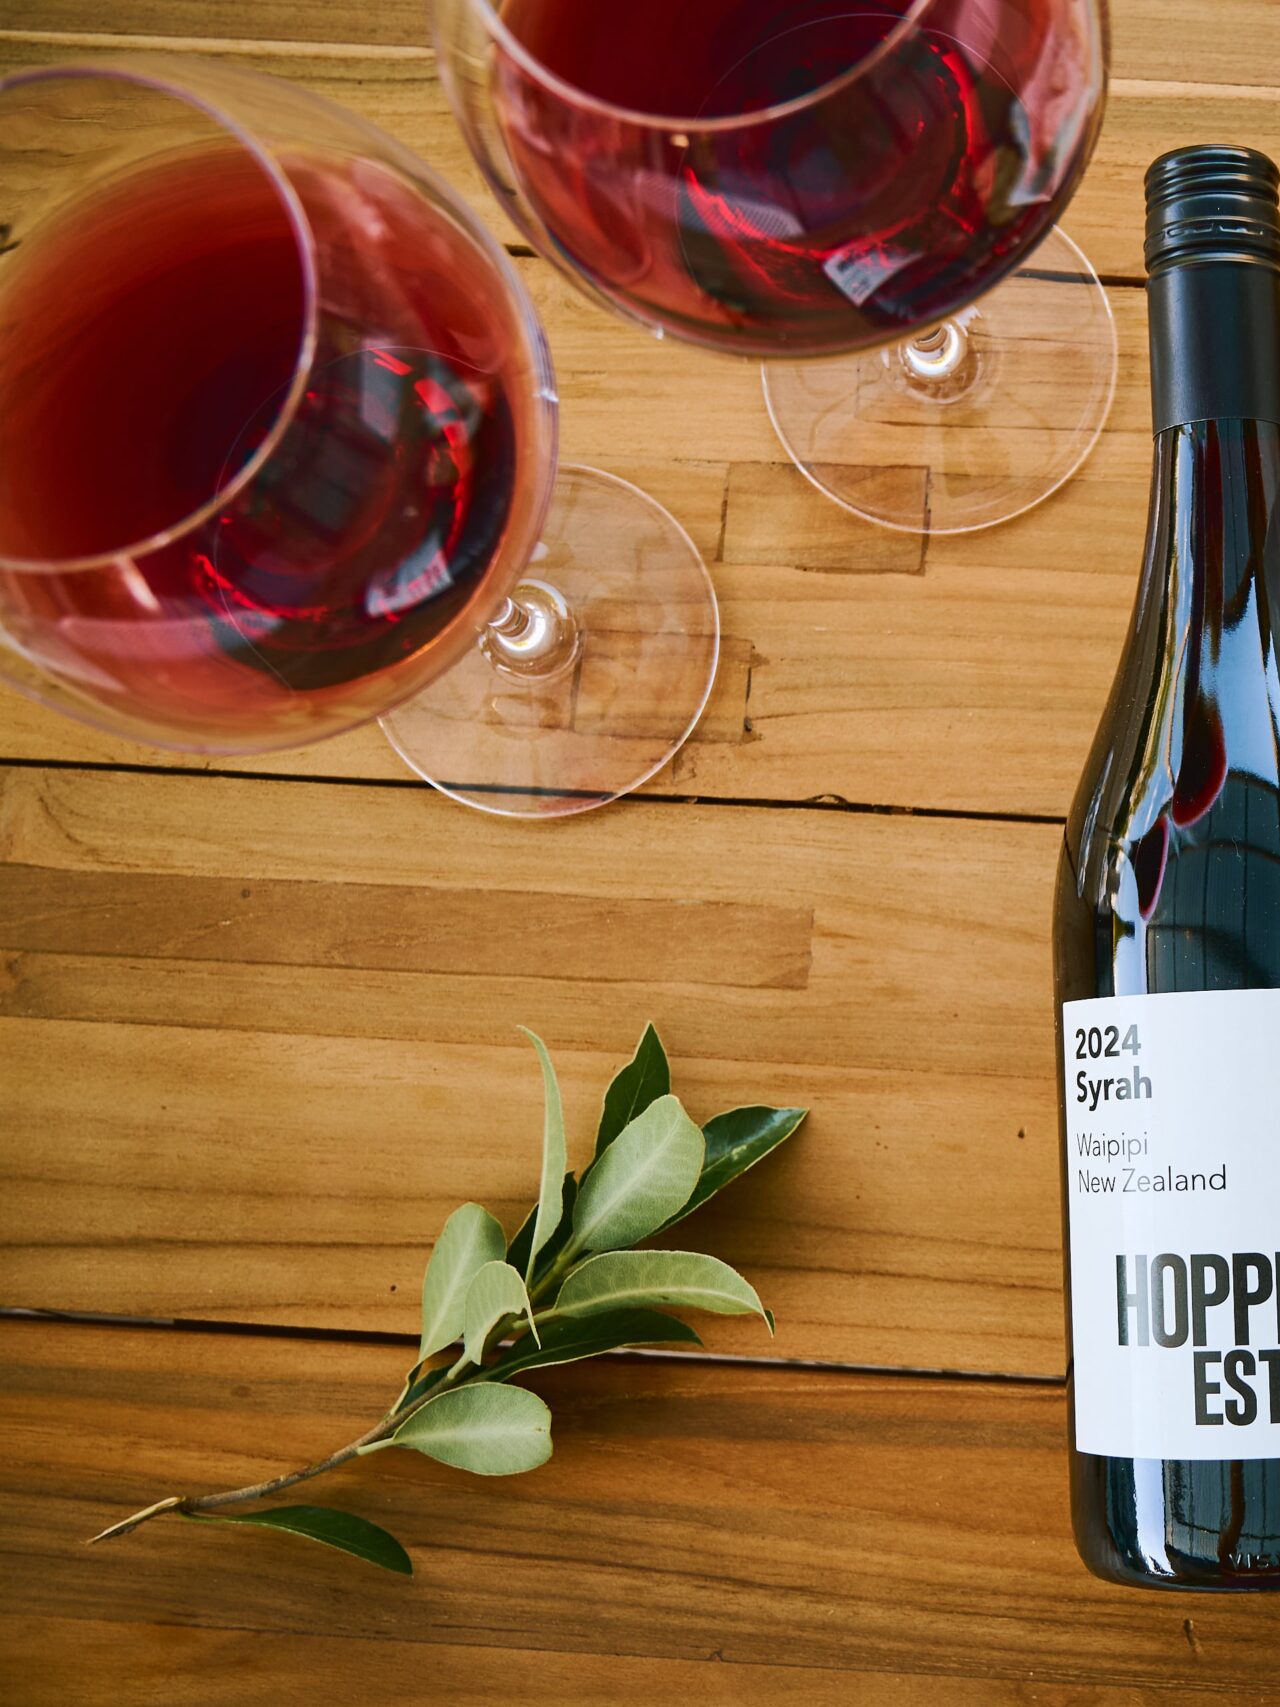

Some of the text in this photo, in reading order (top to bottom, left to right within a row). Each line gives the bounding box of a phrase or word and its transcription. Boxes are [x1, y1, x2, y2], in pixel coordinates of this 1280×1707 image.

[1075, 1023, 1142, 1060] 2024
[1076, 1065, 1153, 1112] Syrah
[1076, 1131, 1148, 1163] Waipipi
[1078, 1164, 1227, 1193] New Zealand
